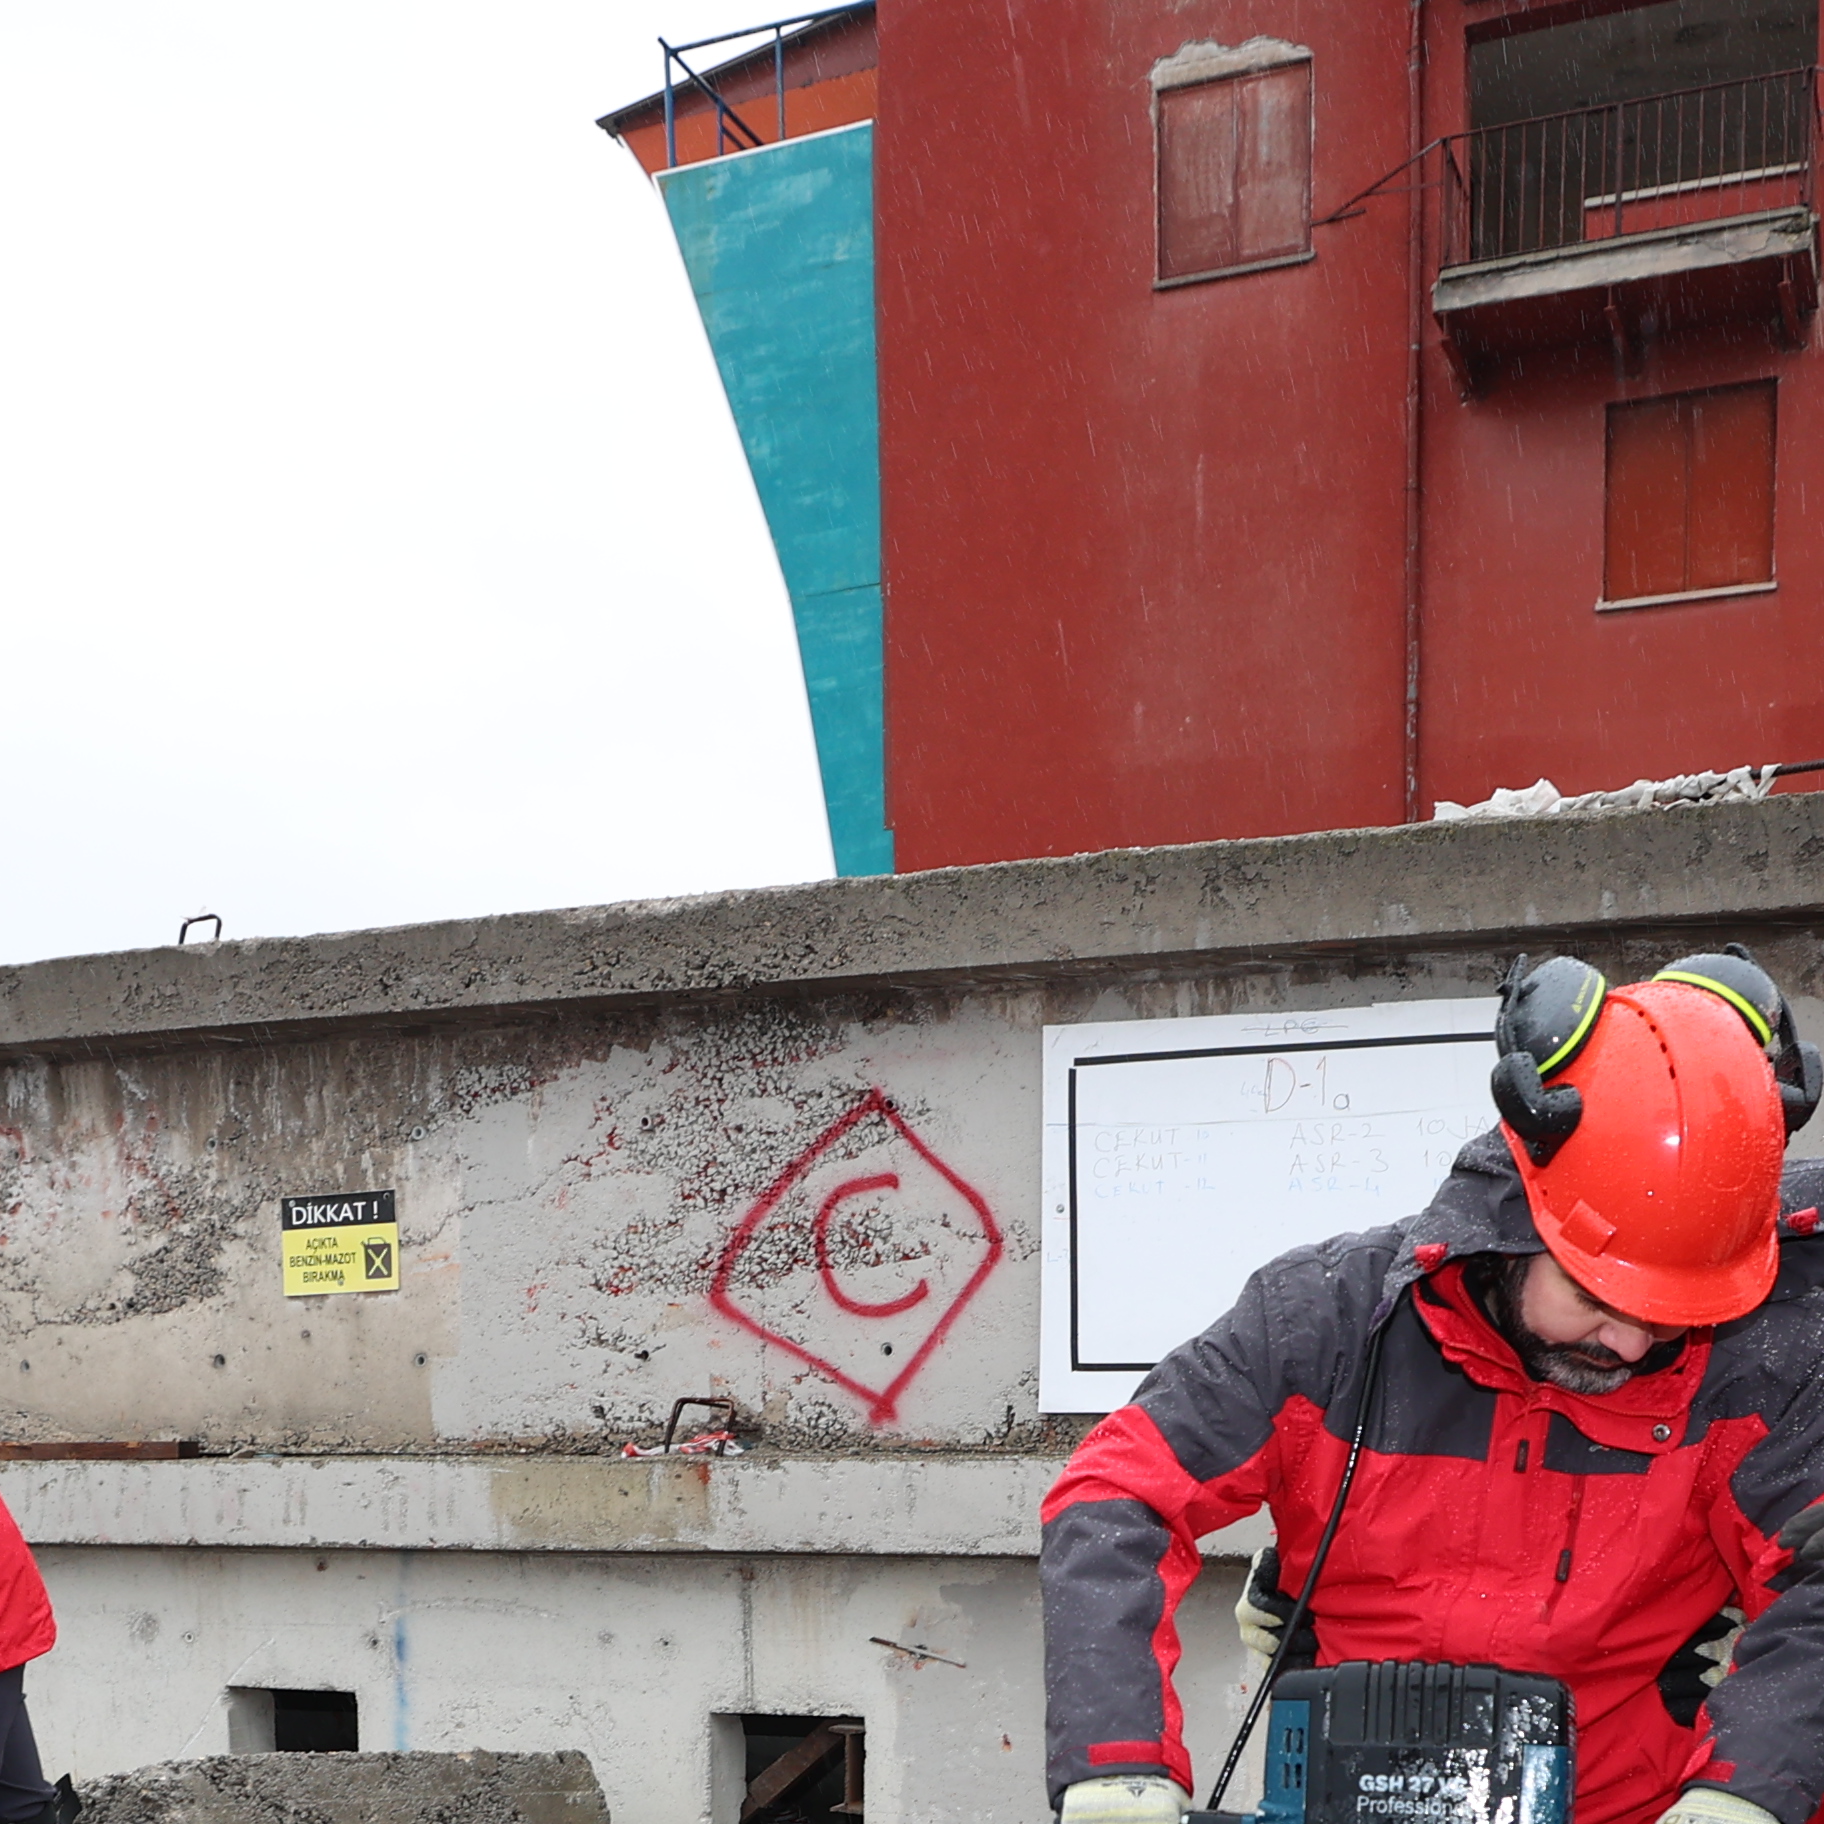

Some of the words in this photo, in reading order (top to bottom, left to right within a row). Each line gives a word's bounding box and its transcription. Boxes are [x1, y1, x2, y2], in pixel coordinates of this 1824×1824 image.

[291, 1201, 366, 1226] DİKKAT
[305, 1237, 338, 1254] AÇIKTA
[813, 1172, 929, 1318] C
[1359, 1774, 1404, 1792] GSH
[1408, 1776, 1435, 1793] 27
